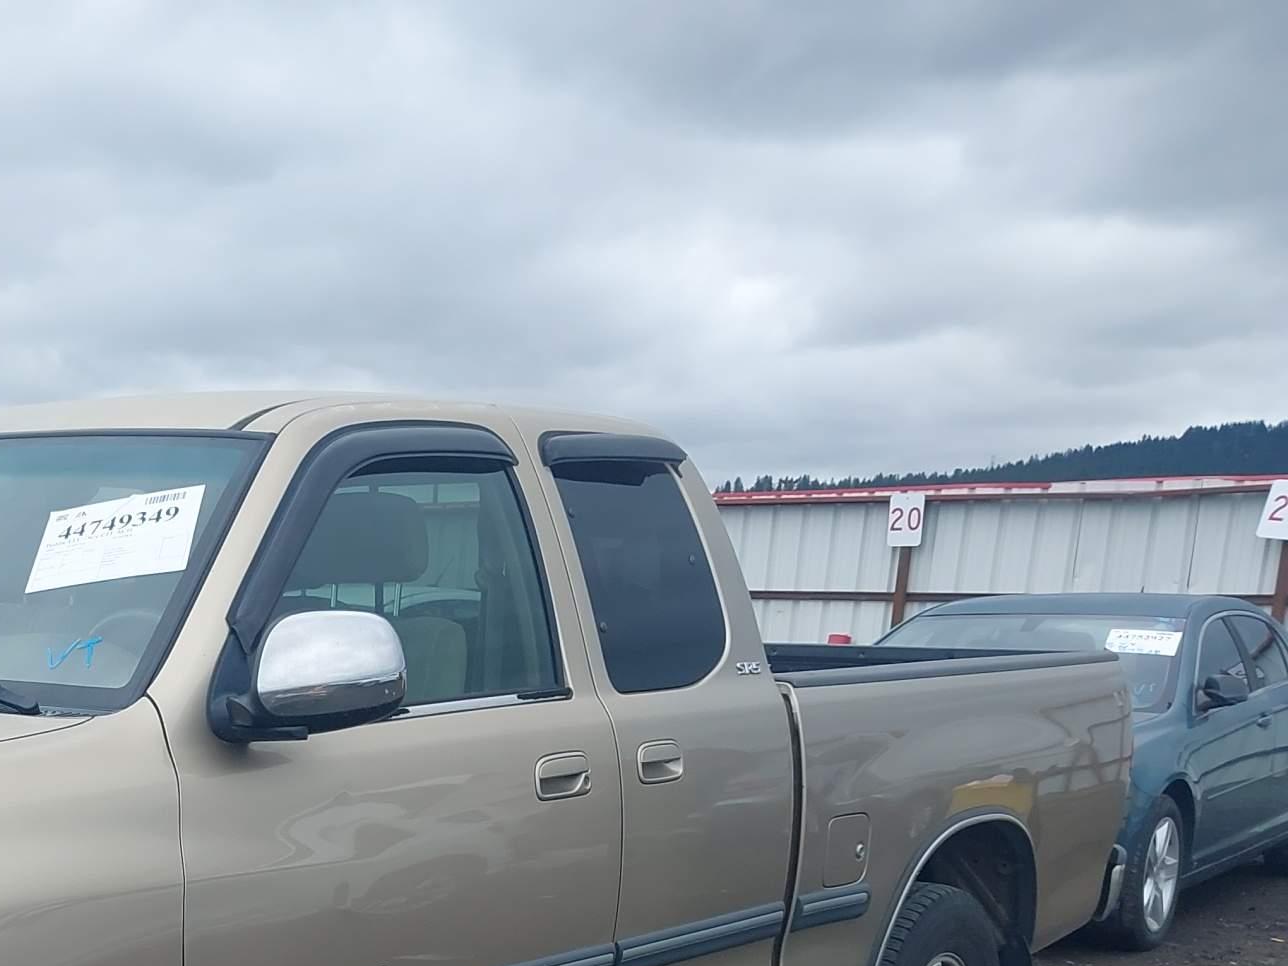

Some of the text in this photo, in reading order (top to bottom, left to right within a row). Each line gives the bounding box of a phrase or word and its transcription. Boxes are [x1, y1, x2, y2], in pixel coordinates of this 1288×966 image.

[58, 506, 179, 539] 44749349
[890, 507, 921, 531] 20
[46, 636, 103, 669] VT
[736, 661, 761, 675] SR5
